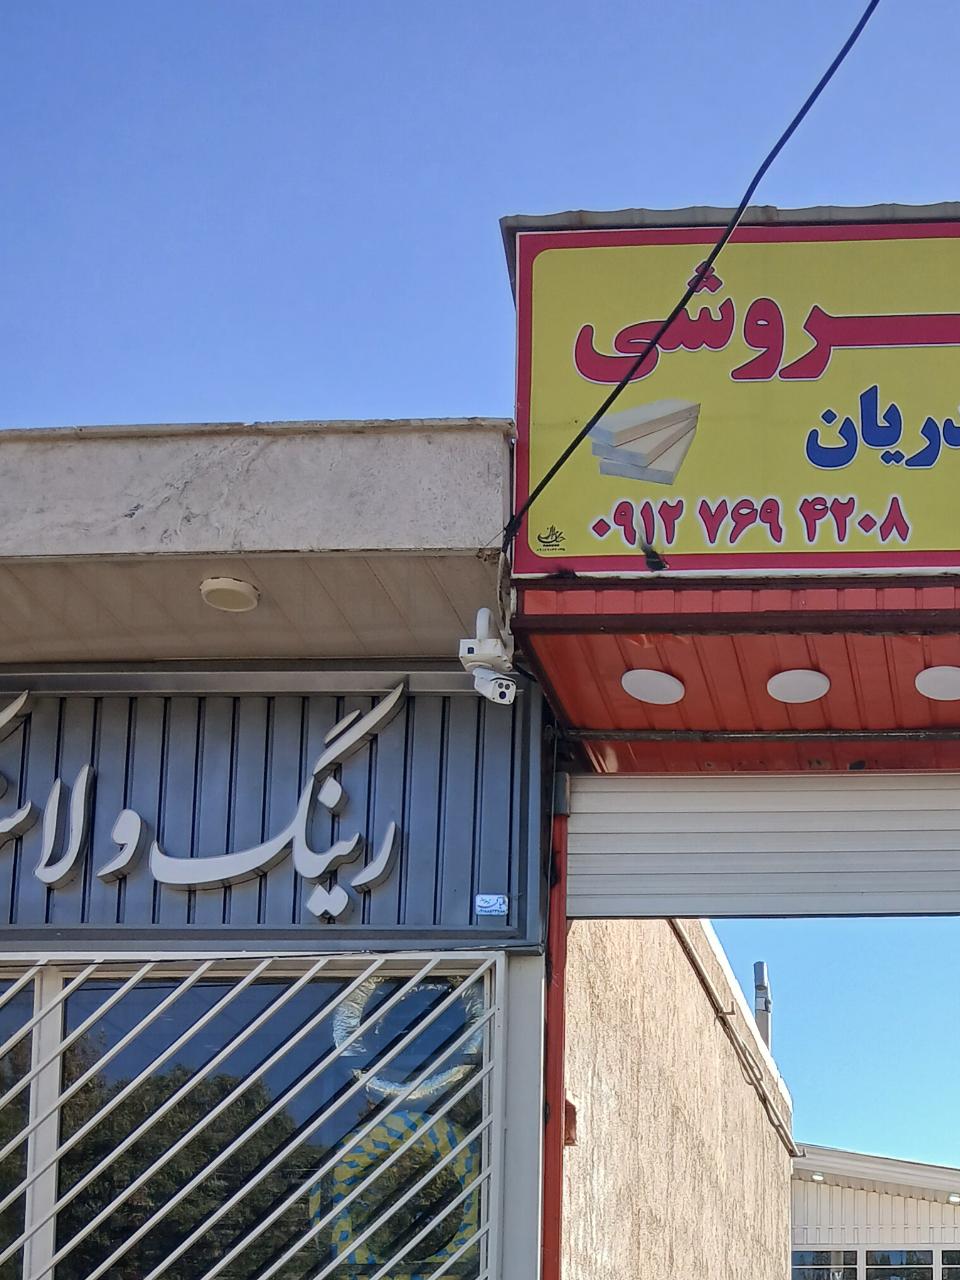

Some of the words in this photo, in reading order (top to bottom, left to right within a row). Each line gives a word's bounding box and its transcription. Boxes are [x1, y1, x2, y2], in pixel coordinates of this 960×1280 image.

[591, 498, 684, 546] ۰۹۱۲
[697, 497, 784, 545] ۷۶۹
[798, 495, 910, 543] ۴۲۰۸
[149, 682, 403, 921] رینگ
[96, 808, 147, 882] و
